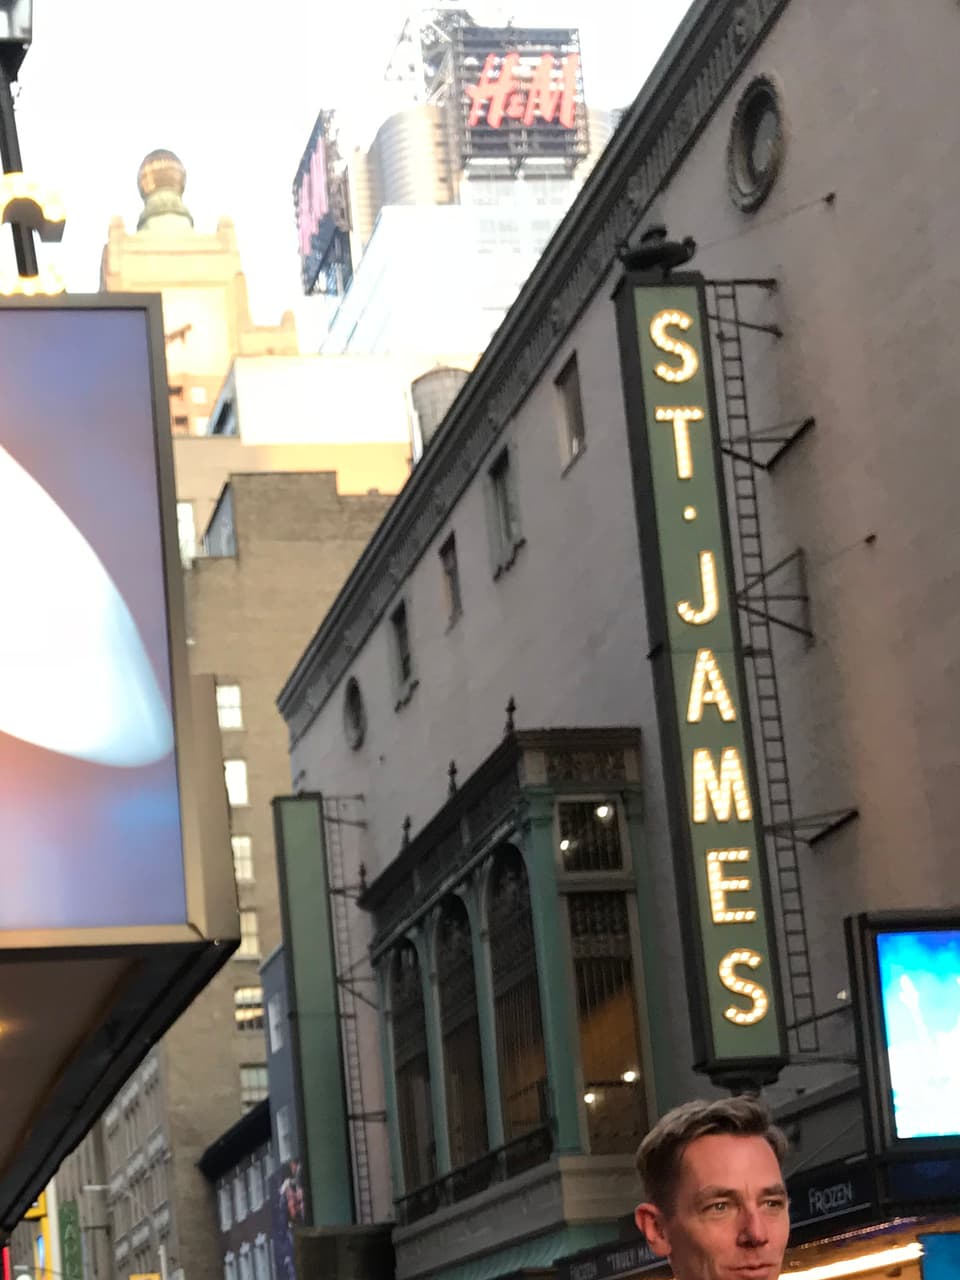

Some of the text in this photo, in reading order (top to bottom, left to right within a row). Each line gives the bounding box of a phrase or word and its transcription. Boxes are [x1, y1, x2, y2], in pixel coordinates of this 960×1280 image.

[465, 53, 581, 129] H&M
[676, 549, 769, 1027] JAMES
[807, 1181, 853, 1215] FROZEN
